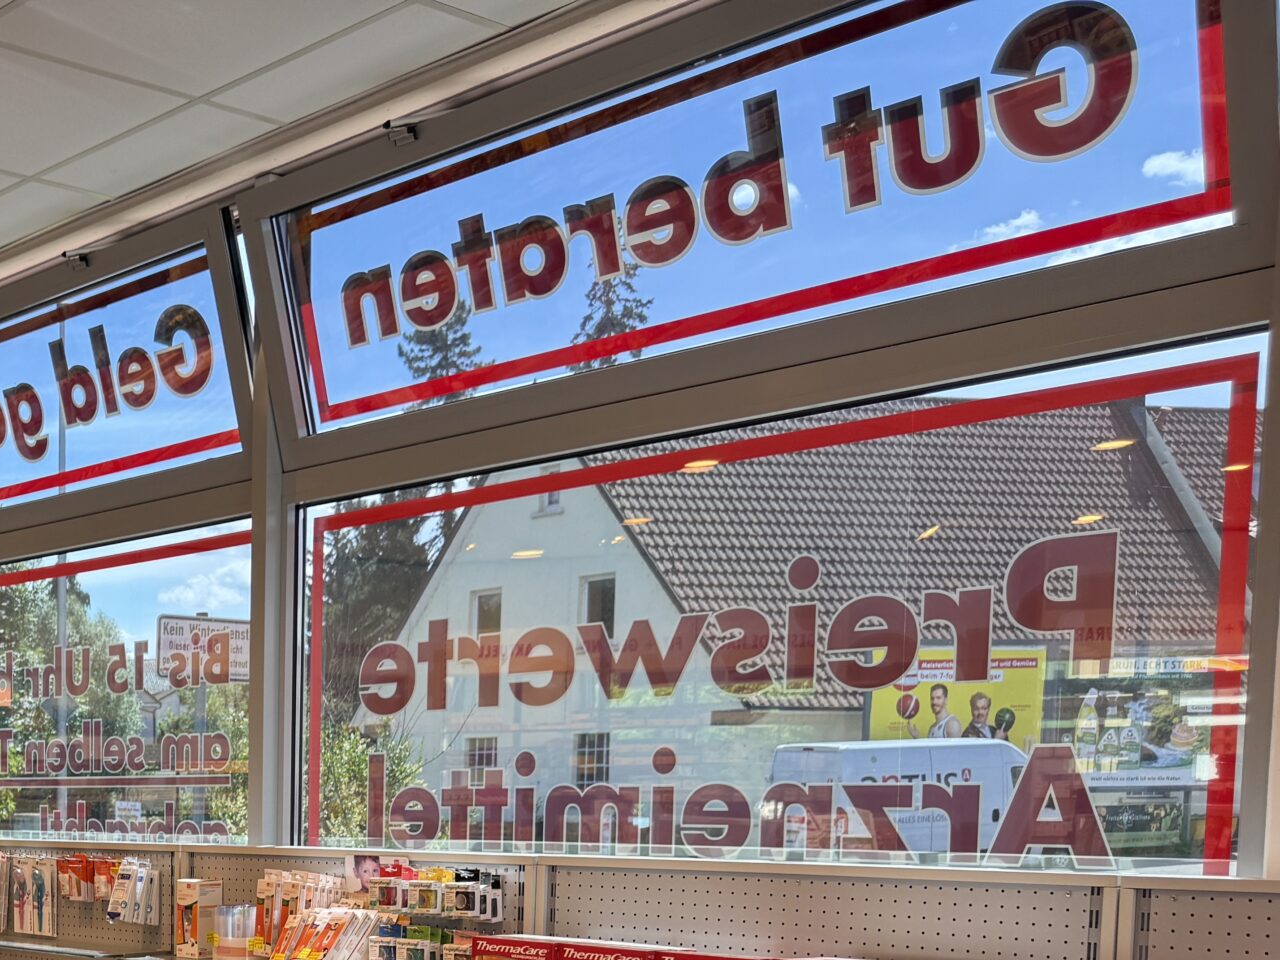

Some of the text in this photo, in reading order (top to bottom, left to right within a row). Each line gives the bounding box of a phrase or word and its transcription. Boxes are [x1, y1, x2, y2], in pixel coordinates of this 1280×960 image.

[163, 622, 184, 636] Kein
[169, 640, 189, 651] Dieser
[1143, 660, 1170, 671] ECHT
[476, 940, 550, 957] ThermaCare
